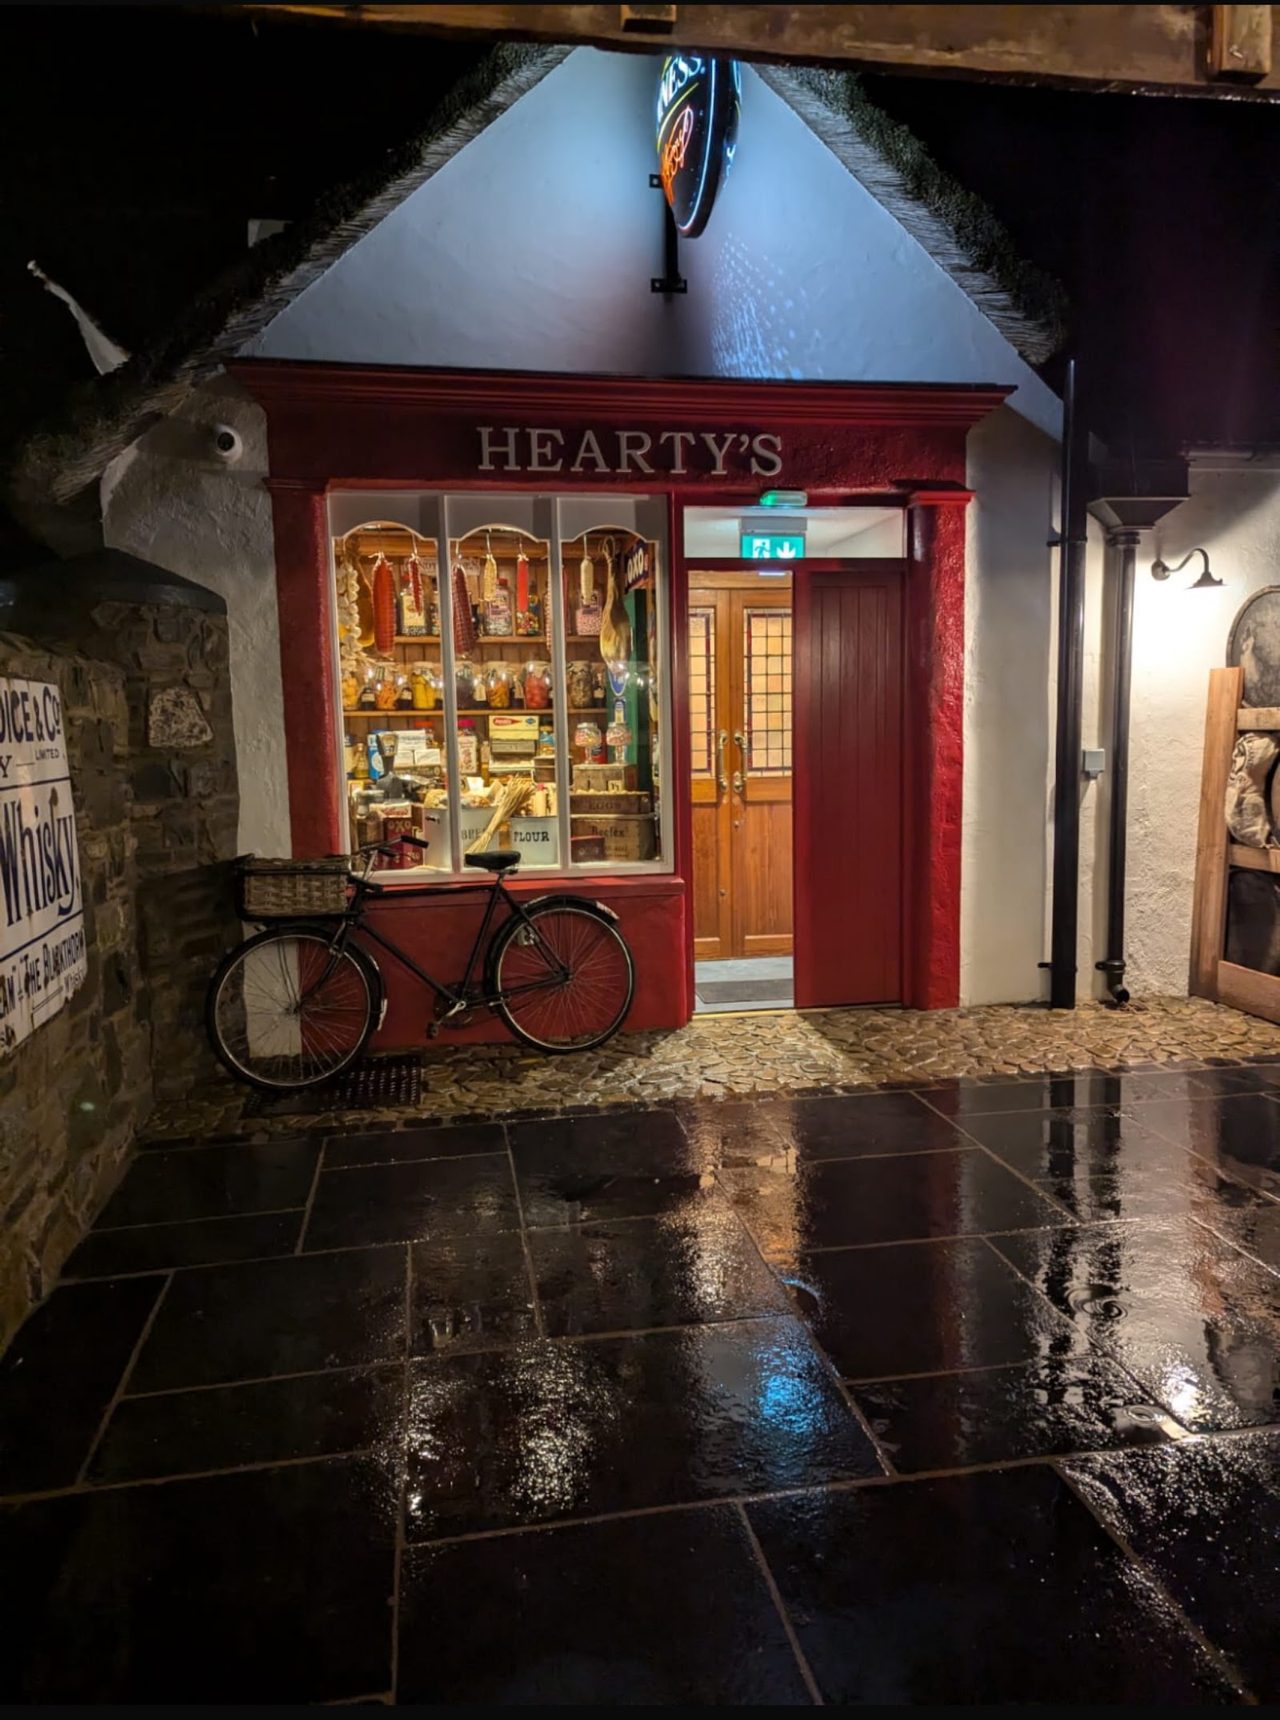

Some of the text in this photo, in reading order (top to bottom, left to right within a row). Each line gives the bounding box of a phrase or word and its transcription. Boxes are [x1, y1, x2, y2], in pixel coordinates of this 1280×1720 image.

[476, 426, 783, 477] HEARTY'S
[33, 695, 45, 742] &
[35, 748, 60, 761] LIMITED
[387, 820, 412, 833] OXO
[513, 831, 550, 842] FLOUR
